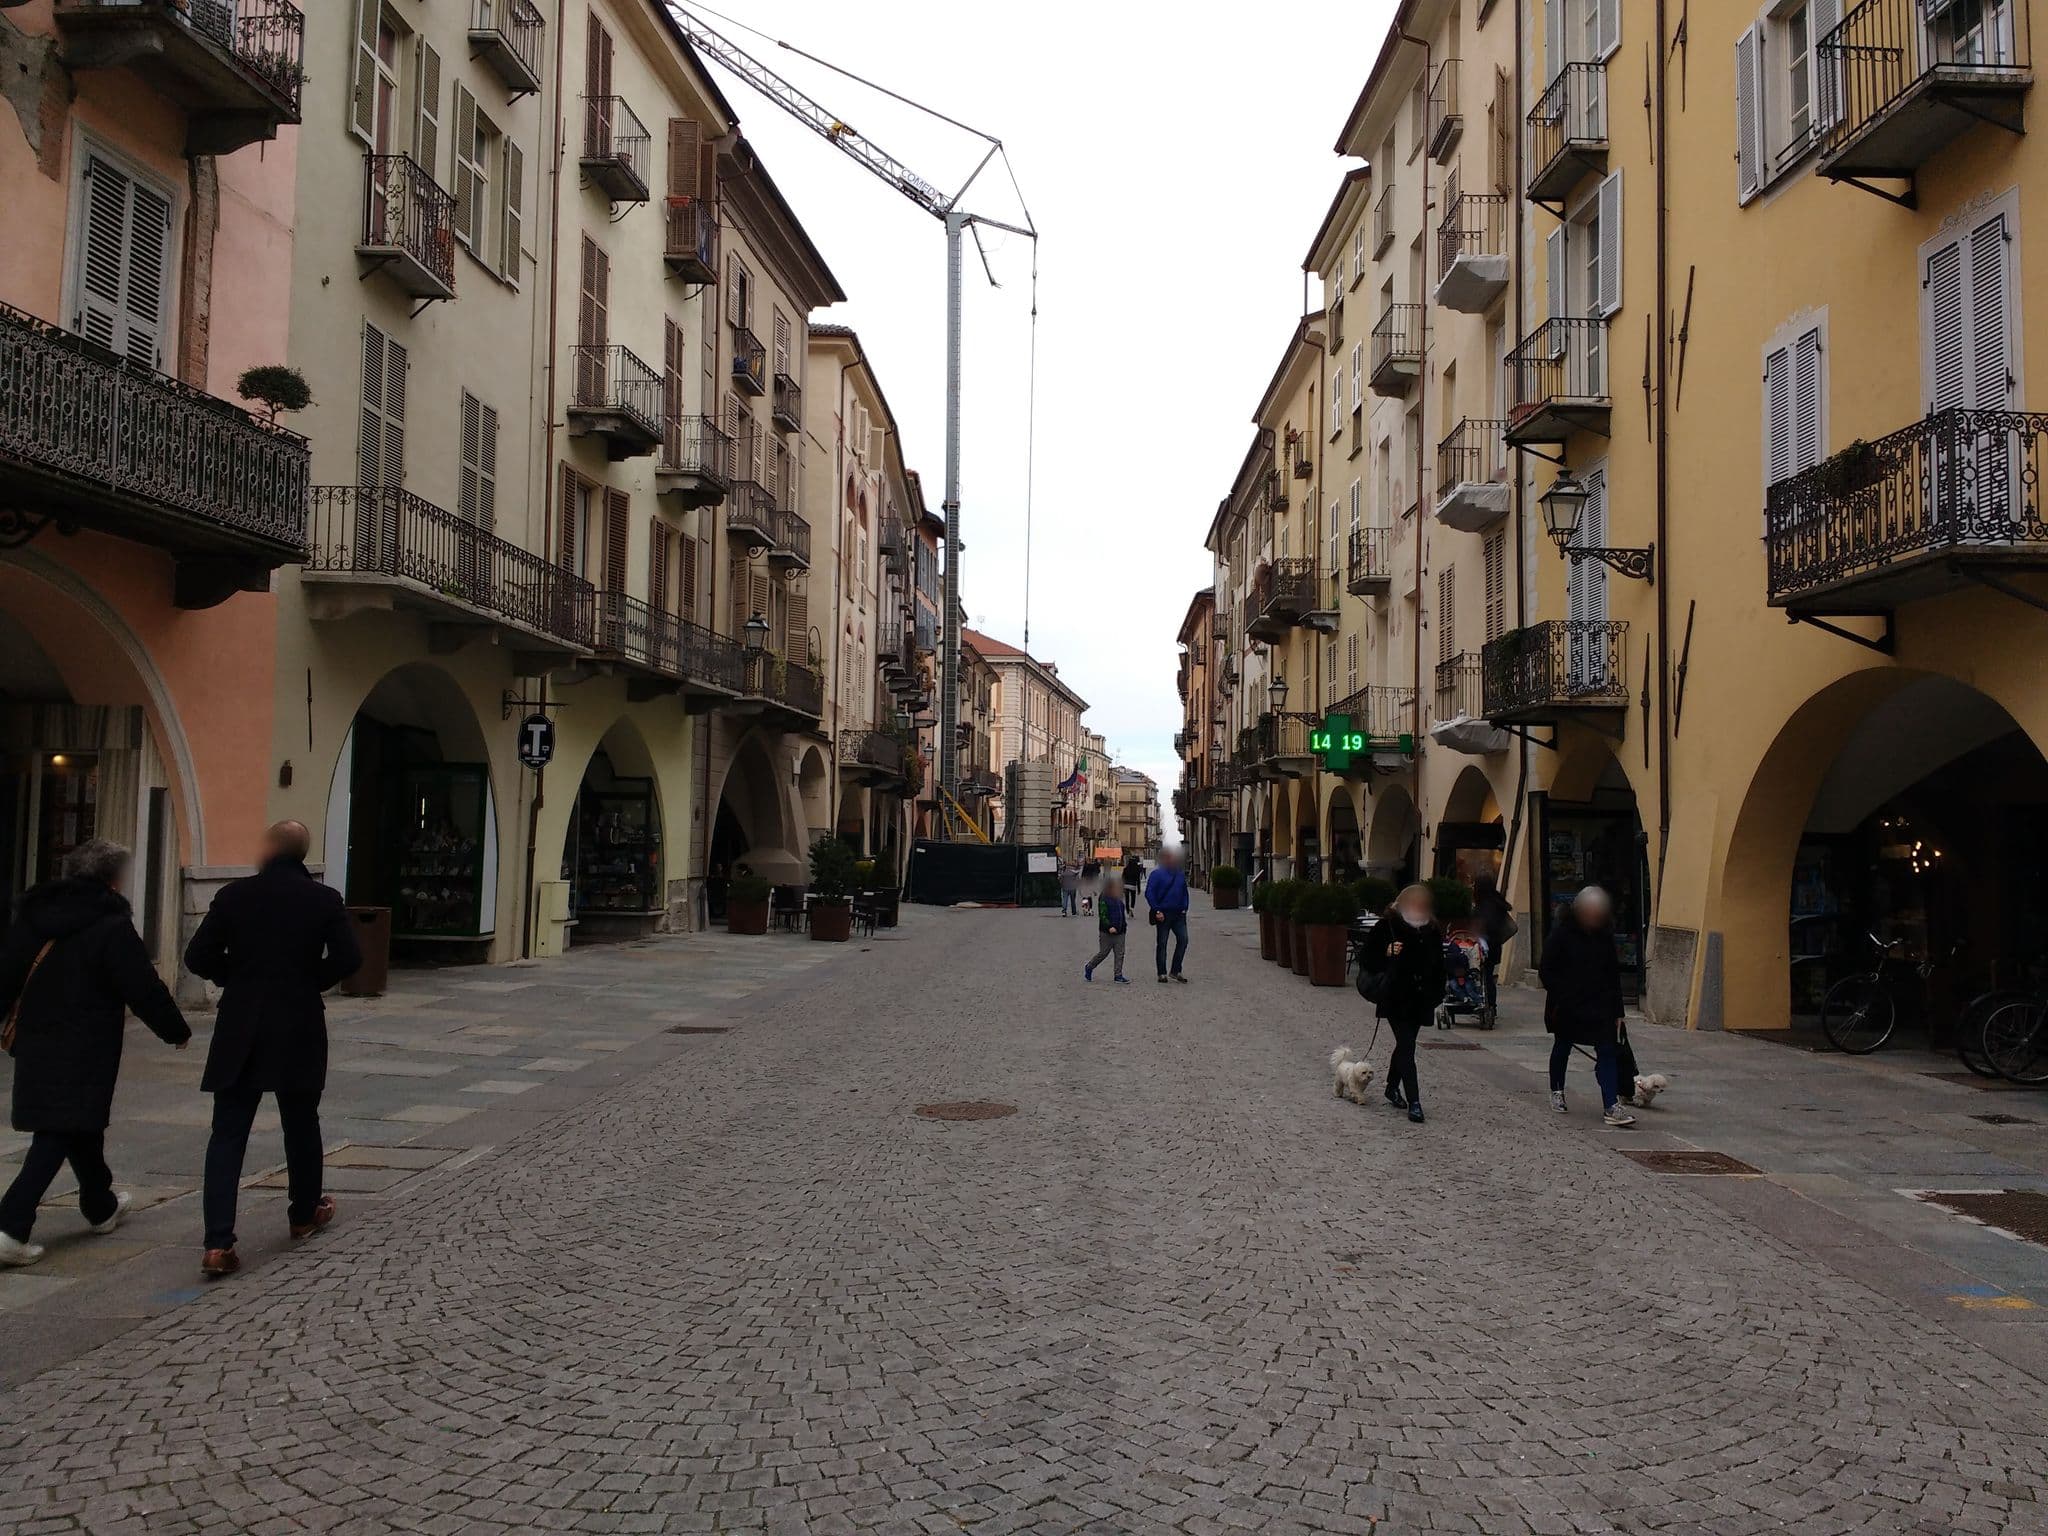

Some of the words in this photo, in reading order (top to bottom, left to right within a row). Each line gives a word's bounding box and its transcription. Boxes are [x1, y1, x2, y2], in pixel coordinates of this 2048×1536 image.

[527, 724, 547, 756] T
[1312, 734, 1332, 749] 14
[1342, 734, 1362, 750] 19
